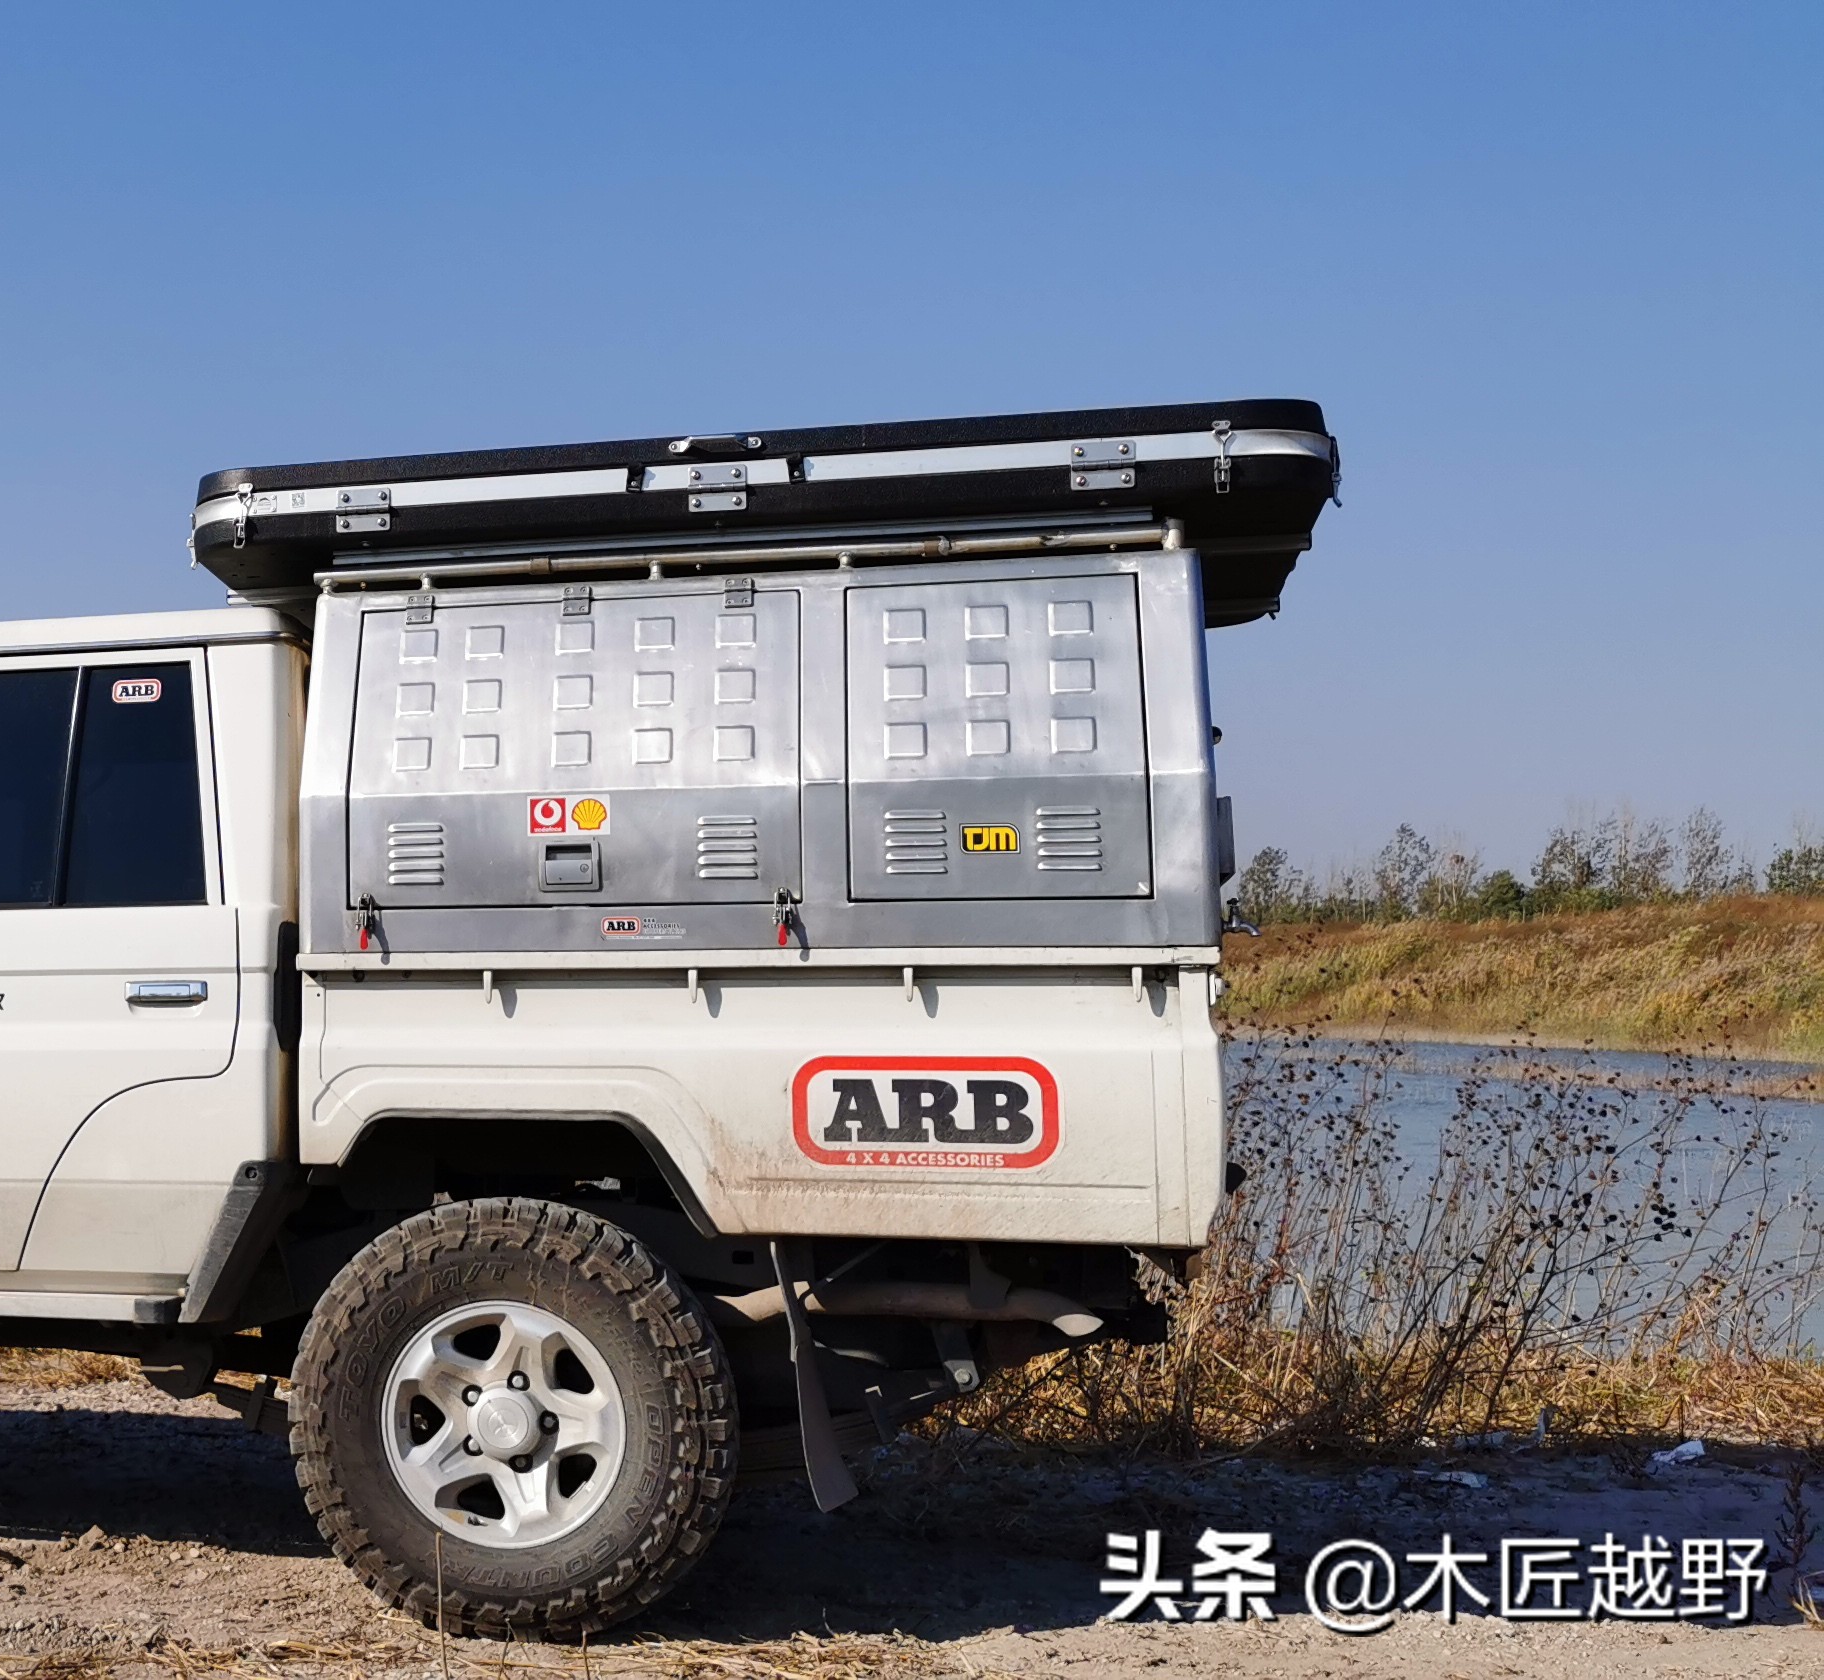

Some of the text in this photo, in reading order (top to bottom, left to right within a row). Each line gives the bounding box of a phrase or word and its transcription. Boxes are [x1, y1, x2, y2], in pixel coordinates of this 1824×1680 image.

[118, 685, 155, 697] ARB
[964, 827, 1016, 850] TJM
[606, 921, 636, 931] ARB
[824, 1078, 1034, 1144] ARB
[896, 1152, 1005, 1167] ACCESSORIES
[338, 1296, 407, 1422] TOYO
[430, 1261, 514, 1294] M/T
[624, 1402, 665, 1529] OPEN
